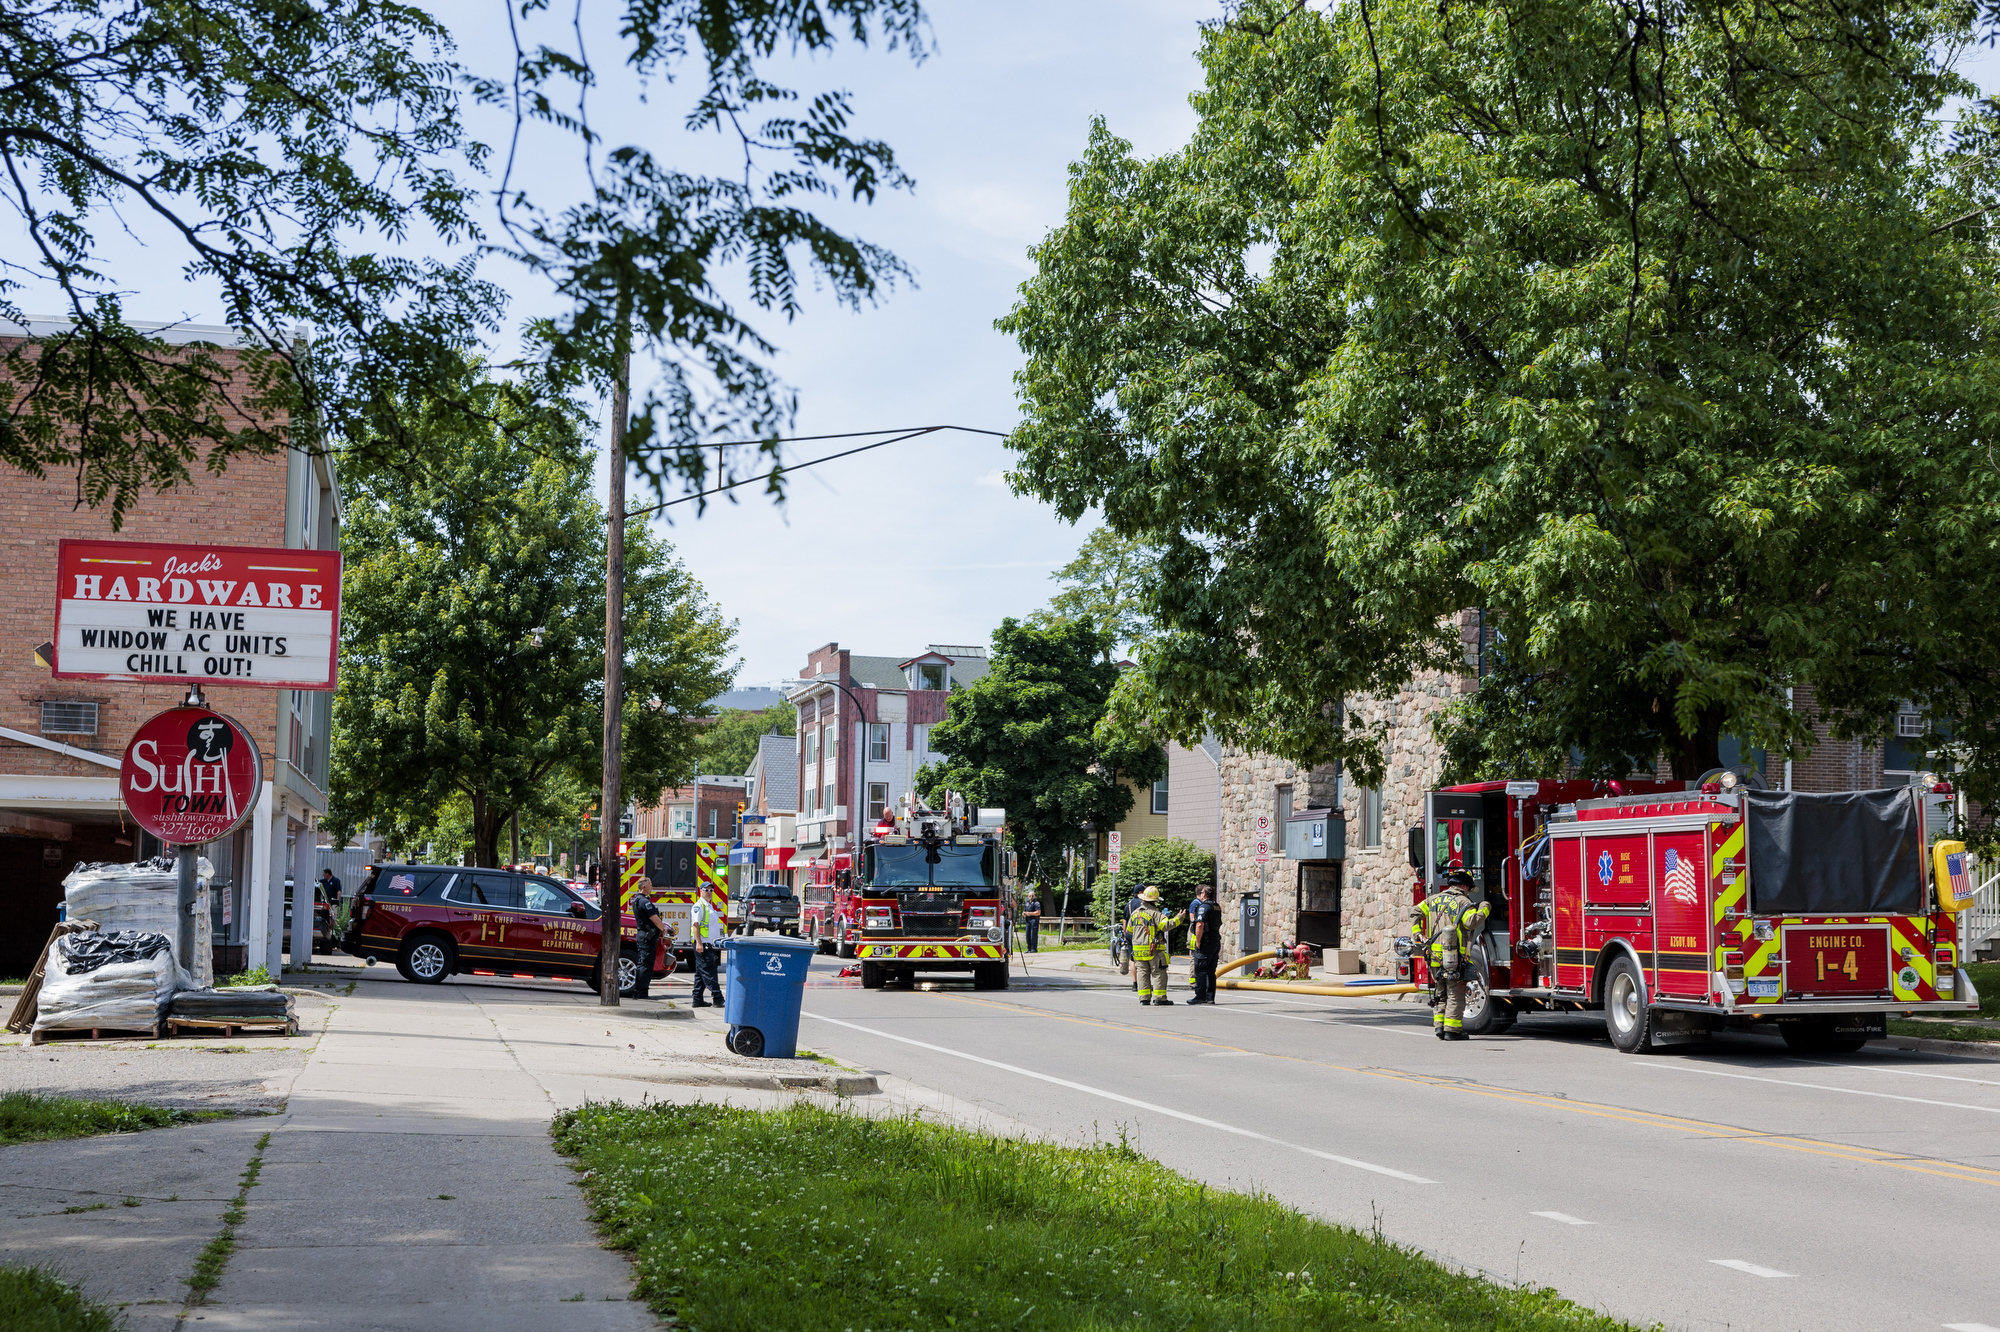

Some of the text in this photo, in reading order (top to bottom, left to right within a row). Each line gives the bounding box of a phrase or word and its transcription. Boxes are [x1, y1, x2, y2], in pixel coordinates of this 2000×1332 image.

[162, 553, 222, 584] Jack's
[73, 574, 323, 609] HARDWARE
[148, 609, 245, 630] WE HAVE
[81, 629, 288, 655] WINDOW AC UNITS
[126, 654, 253, 676] CHILL OUT!
[162, 795, 227, 813] TOWN
[152, 813, 227, 823] sushitown.org
[654, 857, 688, 870] E 6
[1621, 864, 1630, 872] LIFE
[1618, 875, 1634, 884] SUPPORT
[473, 914, 514, 924] BATT. CHIEF
[481, 923, 505, 943] 1-1
[542, 920, 587, 935] ANN ARBOR
[554, 930, 573, 940] FIRE
[542, 940, 584, 950] DEPARTMENT
[1809, 936, 1865, 948] ENGINE CO.
[1815, 950, 1859, 982] 1-4
